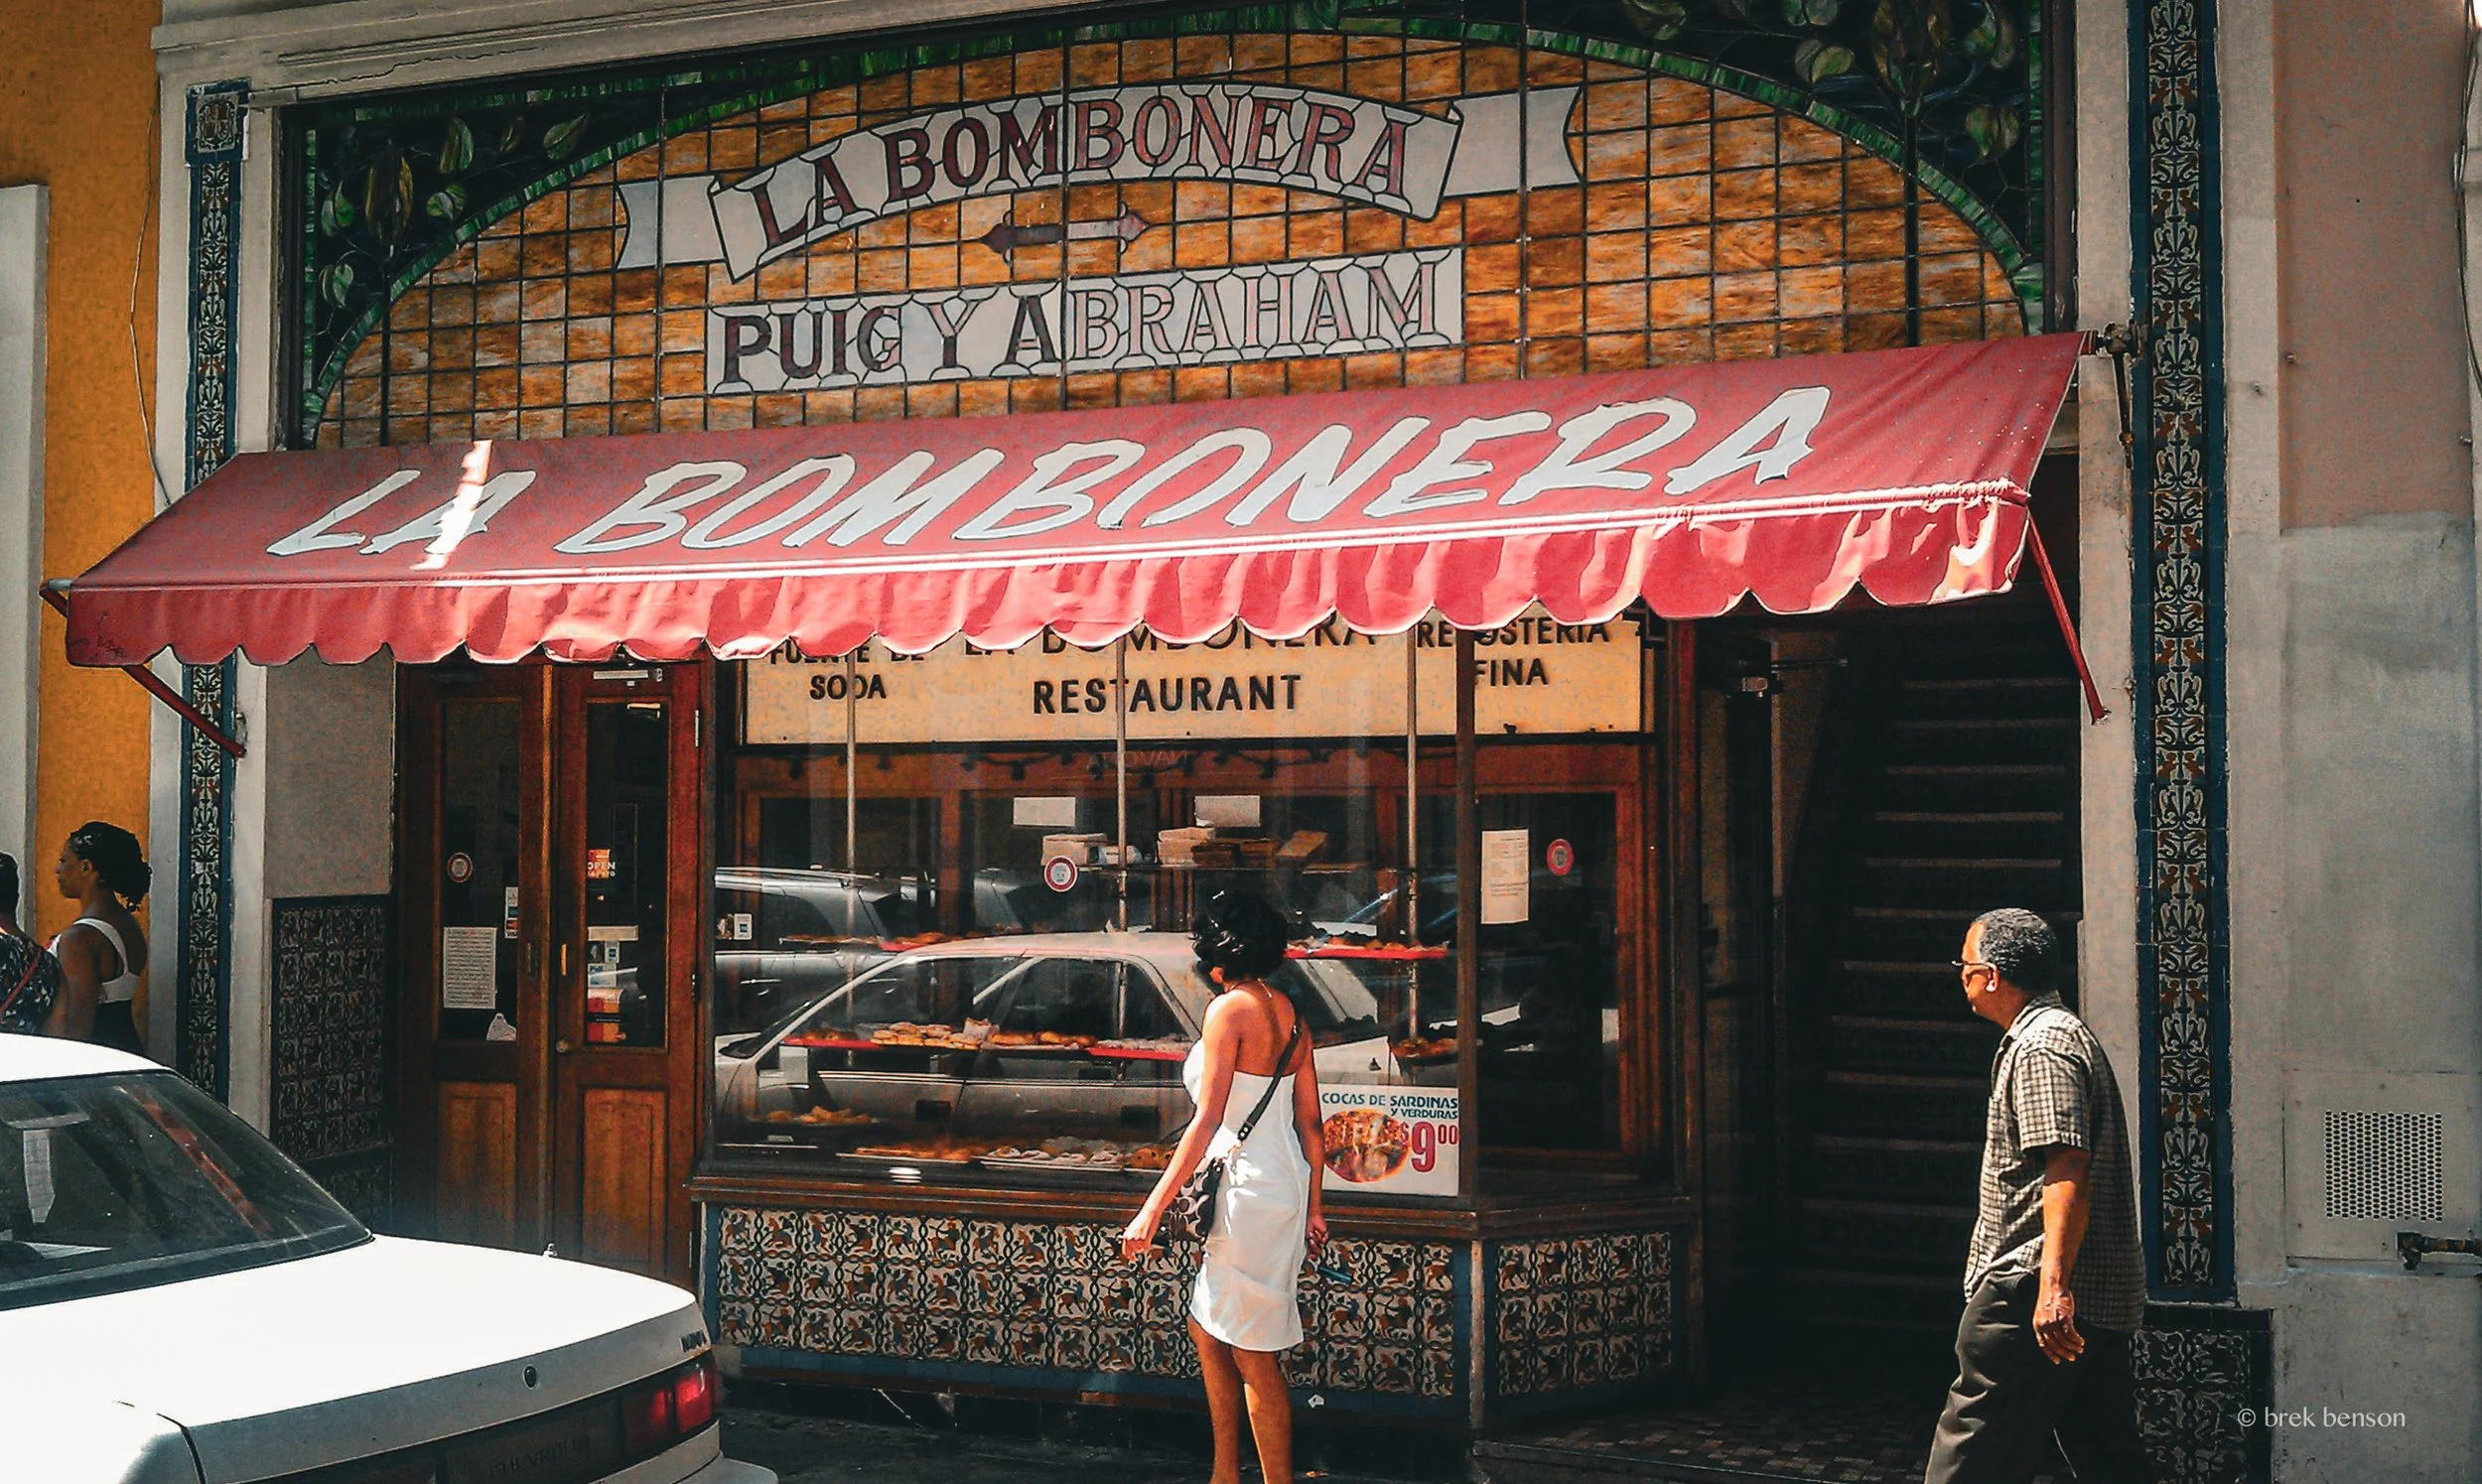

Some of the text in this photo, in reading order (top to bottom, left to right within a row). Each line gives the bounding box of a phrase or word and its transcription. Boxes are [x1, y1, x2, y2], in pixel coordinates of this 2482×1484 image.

[751, 94, 1408, 247] LA BOMBONERA
[723, 260, 1439, 384] PUIG Y ABRAHAM
[265, 385, 1832, 556] LA BOMBONERA
[1417, 616, 1610, 648] REOSTERIA
[809, 674, 887, 701] SODA
[1475, 658, 1550, 687] FINA
[1033, 674, 1302, 715] RESTAURANT
[1321, 1092, 1458, 1109] COCAS DE SARDINAS
[1401, 1109, 1458, 1119] VERDURAS
